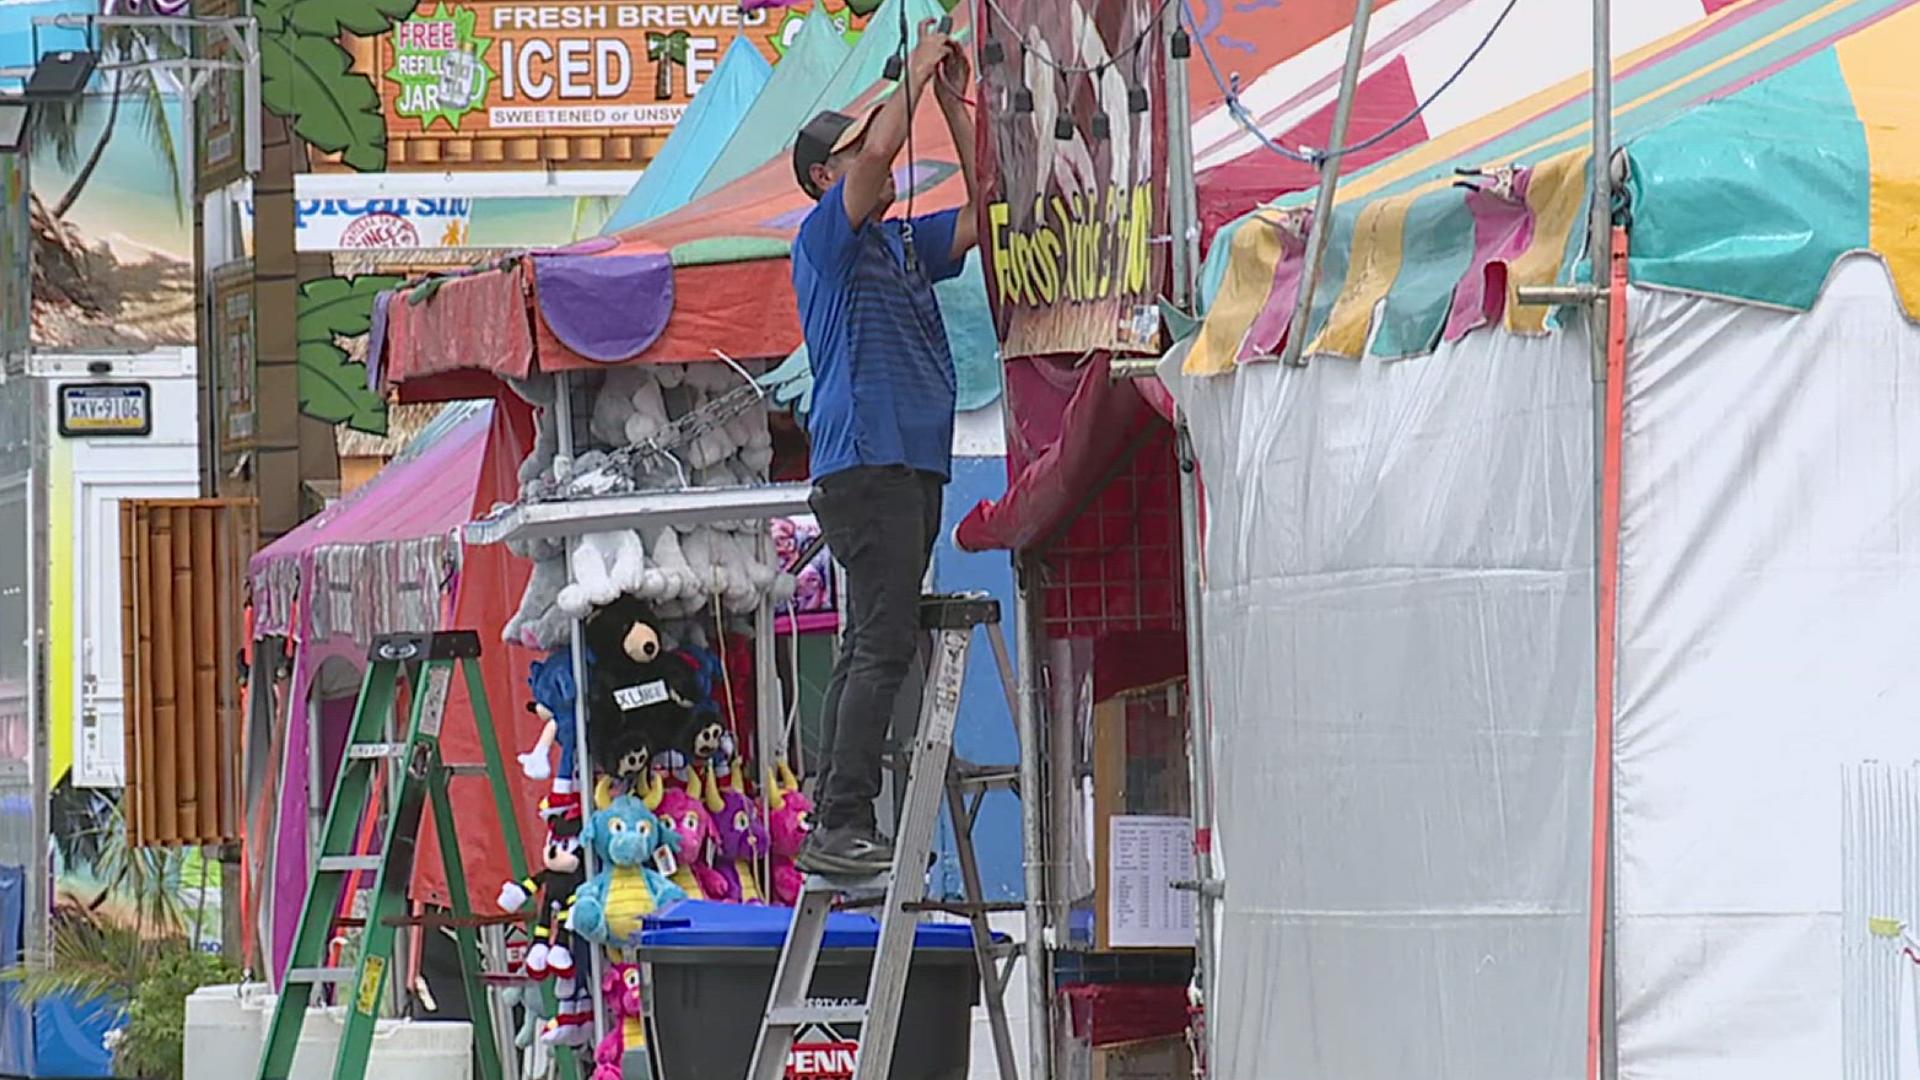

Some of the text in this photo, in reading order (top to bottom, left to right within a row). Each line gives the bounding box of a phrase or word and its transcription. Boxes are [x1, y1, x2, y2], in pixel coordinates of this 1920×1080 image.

[494, 5, 767, 29] FRESH BREWED
[399, 22, 455, 49] FREE
[399, 55, 444, 75] REFILL
[501, 37, 718, 99] ICED TE
[400, 84, 441, 112] JAR
[494, 109, 605, 123] SWEETENED
[611, 111, 628, 121] or
